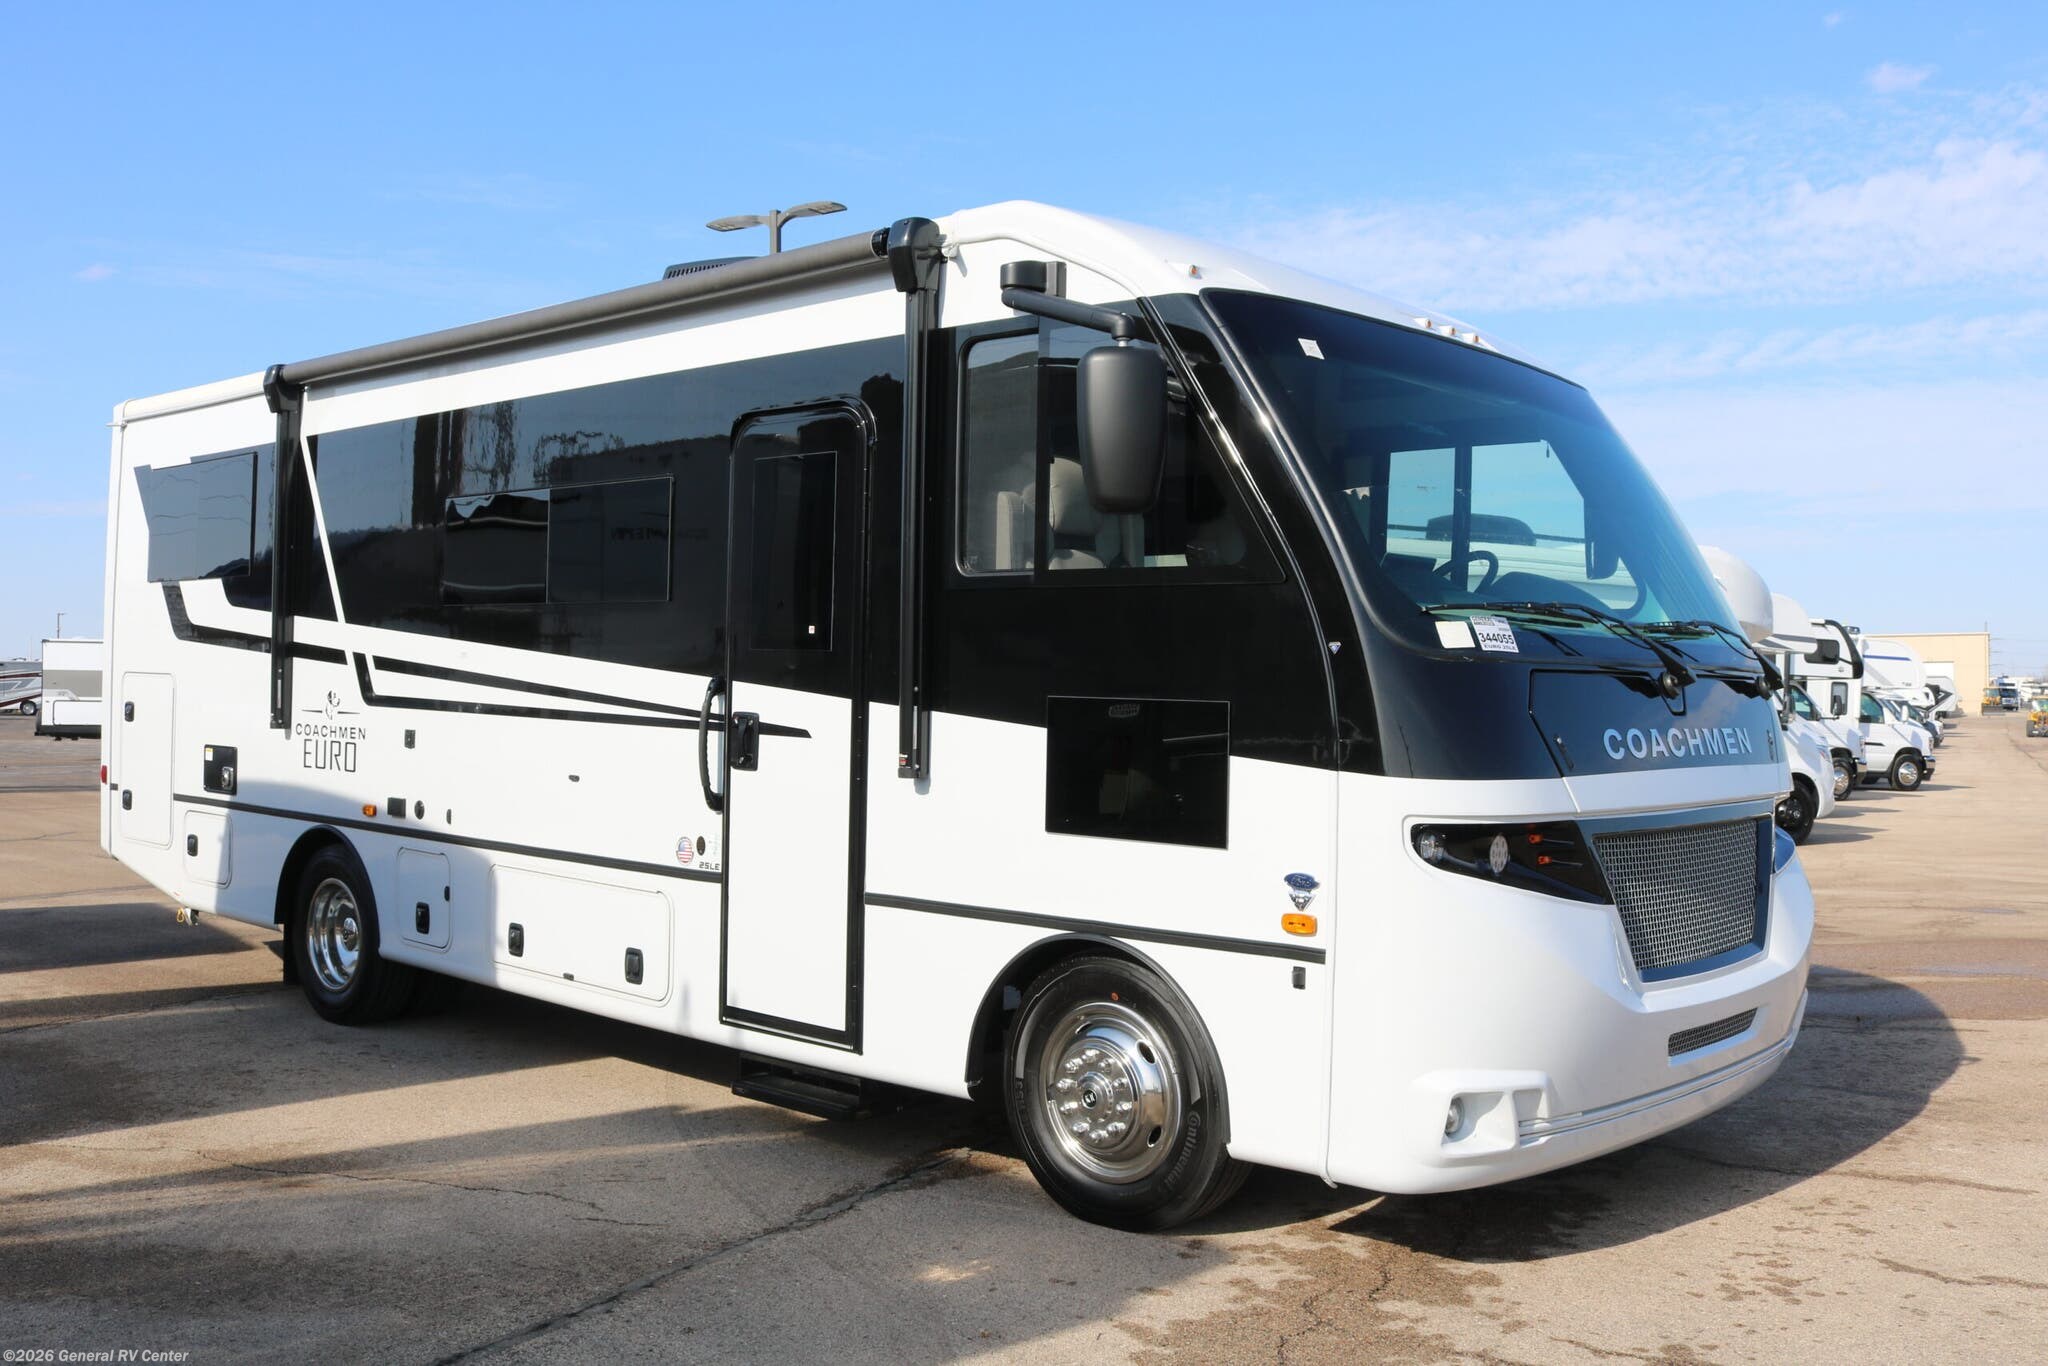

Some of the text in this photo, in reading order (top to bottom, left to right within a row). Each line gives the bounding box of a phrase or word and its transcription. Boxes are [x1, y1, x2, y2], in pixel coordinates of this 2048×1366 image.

[1479, 633, 1515, 644] 344055
[296, 723, 366, 740] COACHMEN
[1603, 728, 1752, 760] COACHMEN
[304, 739, 356, 772] EURO
[699, 862, 720, 870] 25LE
